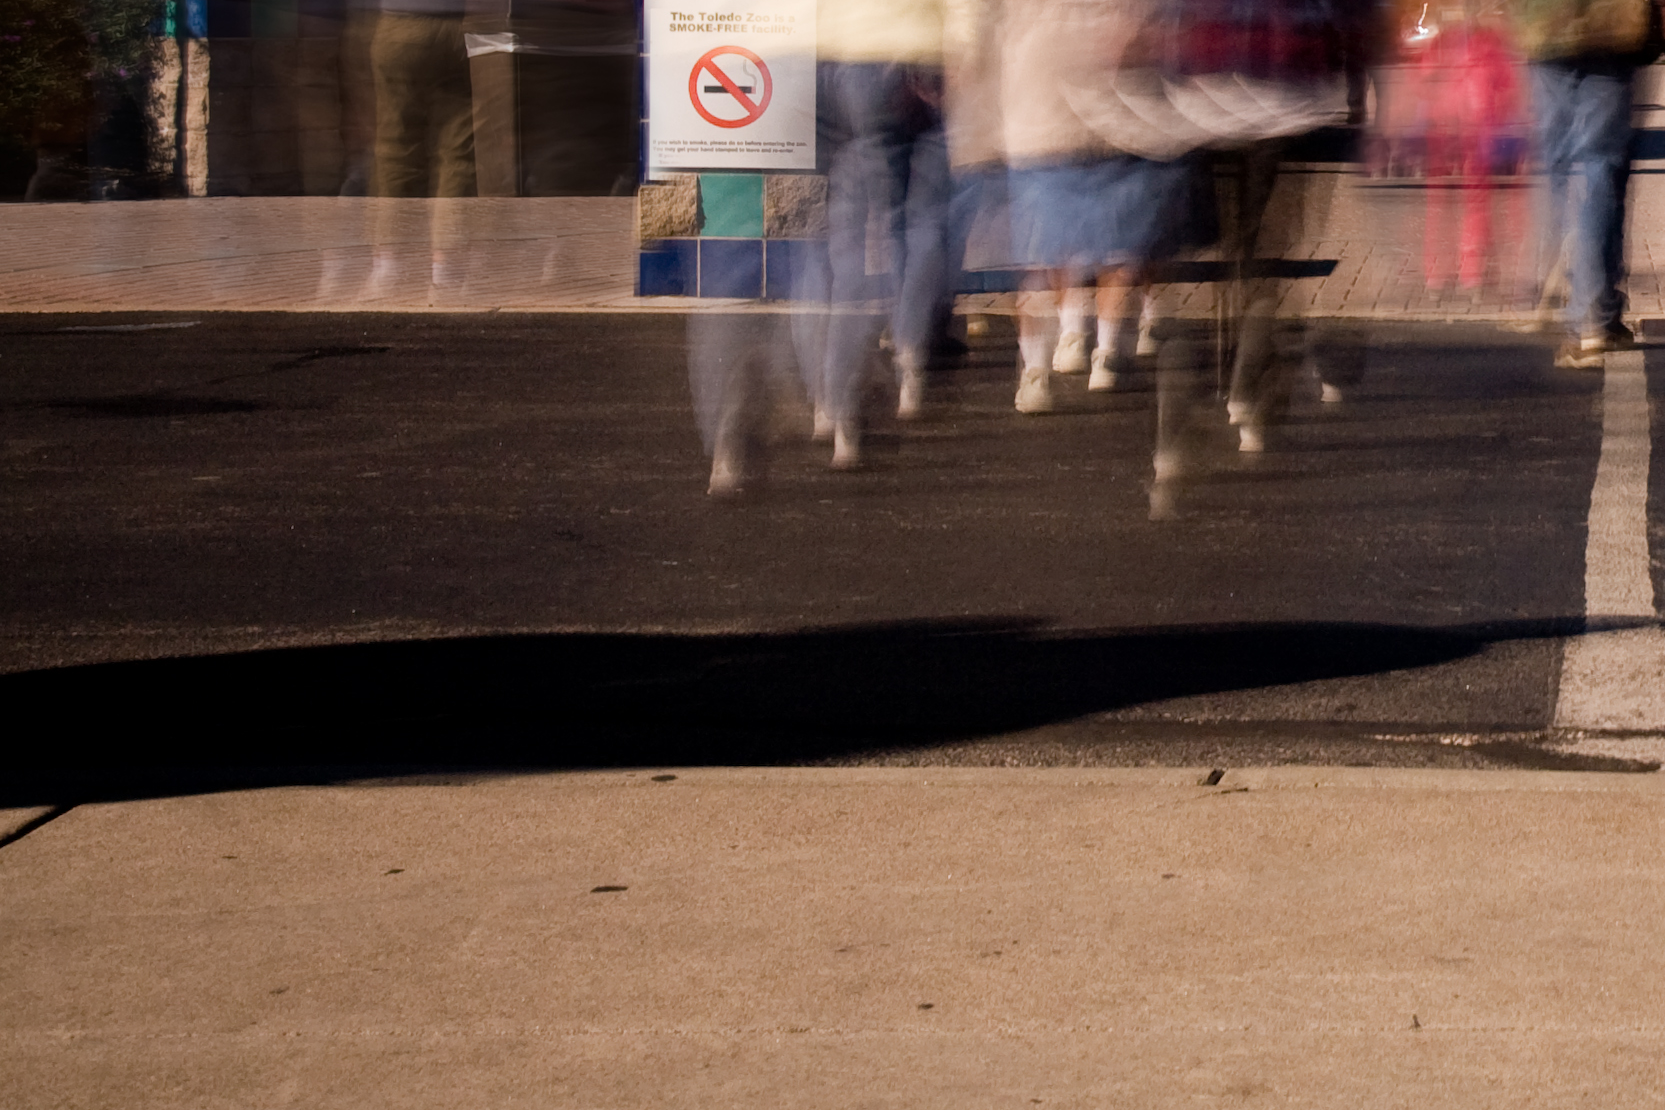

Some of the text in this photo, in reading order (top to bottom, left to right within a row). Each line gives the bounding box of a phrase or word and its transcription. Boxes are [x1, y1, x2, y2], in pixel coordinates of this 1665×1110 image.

[670, 12, 796, 23] The Toledo Zoo is a
[669, 23, 796, 35] SMOKE-FREE facility.
